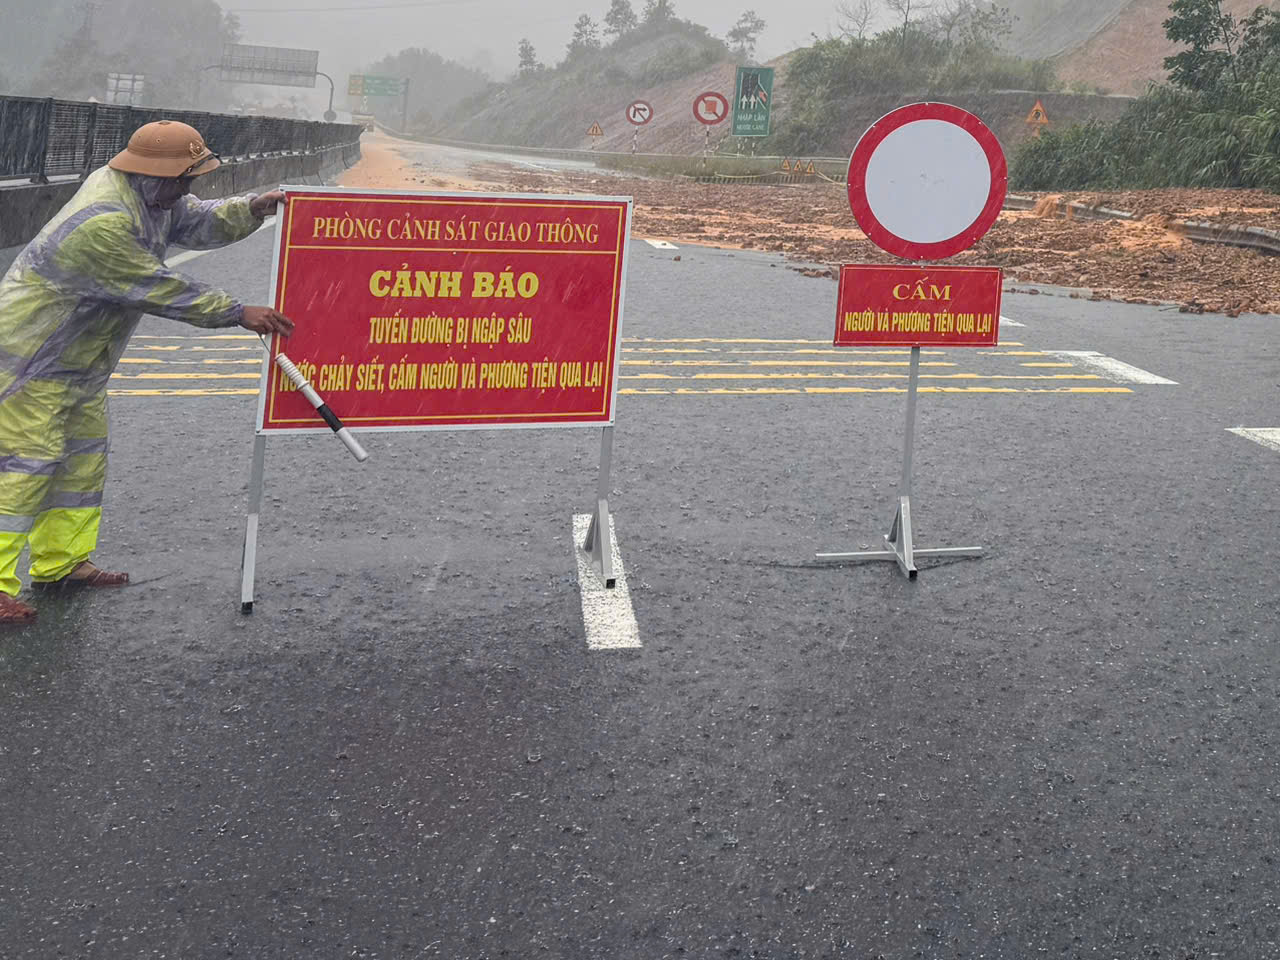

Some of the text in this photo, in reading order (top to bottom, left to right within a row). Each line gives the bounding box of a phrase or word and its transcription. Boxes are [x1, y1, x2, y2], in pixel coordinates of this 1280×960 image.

[312, 211, 600, 244] PHÒNG CẢNH SÁT GIAO THÔNG
[369, 262, 540, 299] CẢNH BÁO
[892, 276, 952, 300] CẤM
[369, 308, 533, 350] TUYẾN ĐƯỜNG BỊ NGẬP SÂU
[843, 307, 992, 337] NGƯỜI VÀ PHƯƠNG TIỆN QUA LẠI
[319, 354, 354, 392] CHẢY
[355, 355, 385, 395] SIẾT,
[388, 353, 418, 390] CẤM
[419, 356, 459, 390] NGƯỜI
[461, 356, 477, 389] VÀ
[479, 359, 529, 389] PHƯƠNG
[531, 356, 558, 394] TIỆN
[559, 361, 583, 390] QUA
[584, 361, 604, 393] LẠI
